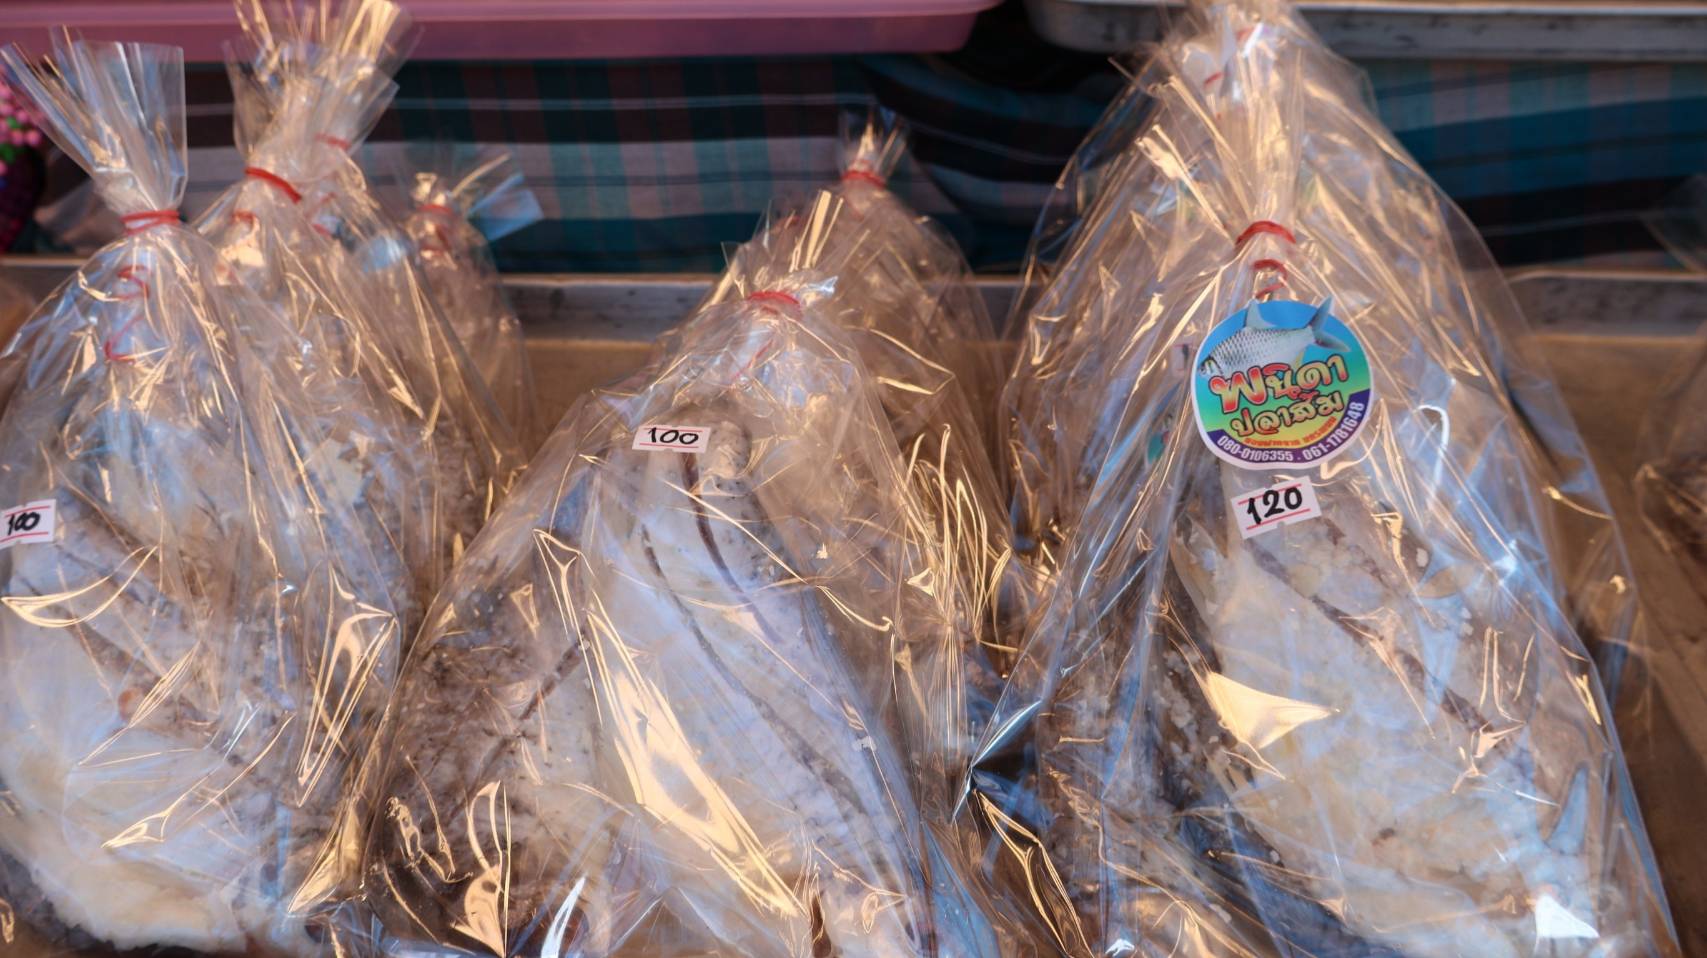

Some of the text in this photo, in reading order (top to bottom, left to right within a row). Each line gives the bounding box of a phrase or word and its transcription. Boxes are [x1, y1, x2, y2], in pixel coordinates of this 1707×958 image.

[1209, 354, 1349, 413] พนิดา
[1217, 435, 1294, 461] 080-0106355
[1303, 402, 1365, 461] 061-1781648
[1230, 390, 1344, 437] ปลาส้ม
[648, 427, 699, 445] 100
[8, 512, 41, 536] 100
[1247, 487, 1302, 525] 120
